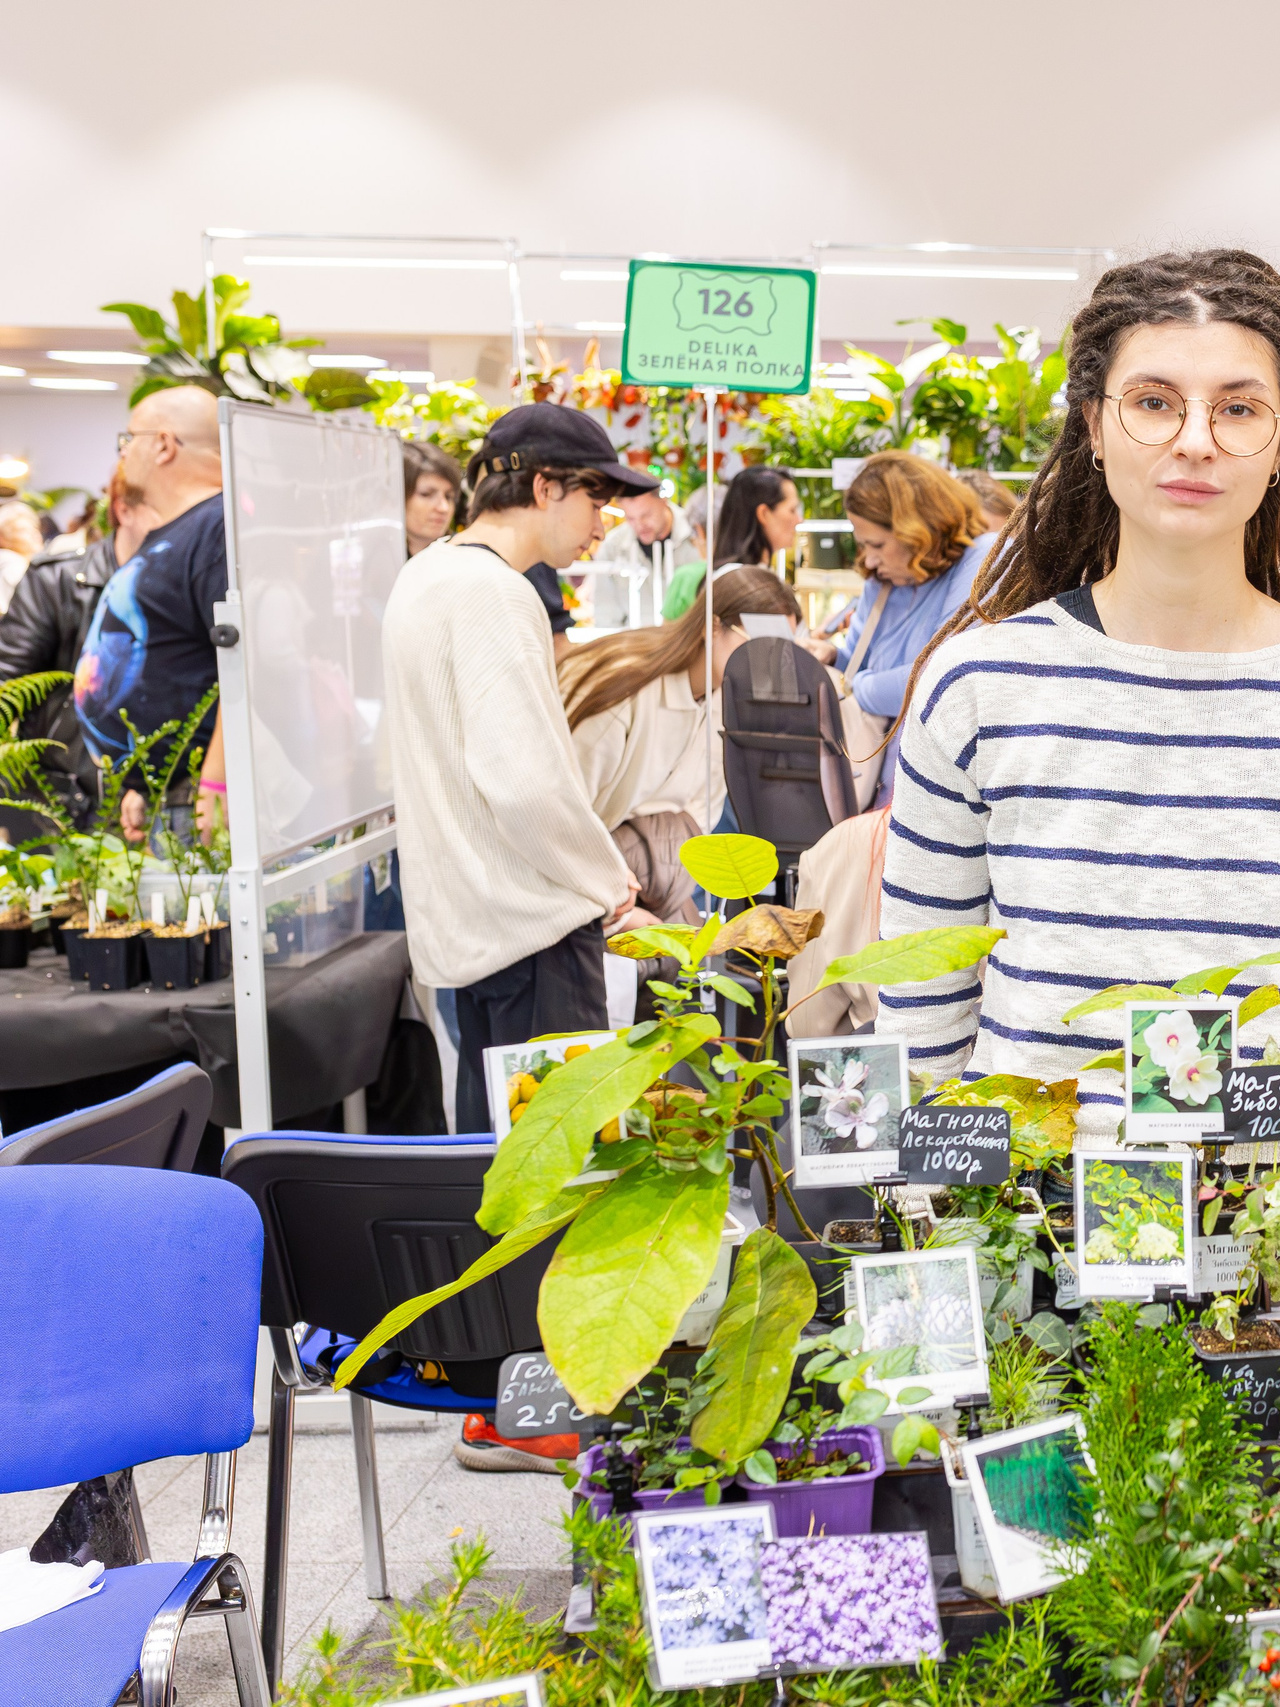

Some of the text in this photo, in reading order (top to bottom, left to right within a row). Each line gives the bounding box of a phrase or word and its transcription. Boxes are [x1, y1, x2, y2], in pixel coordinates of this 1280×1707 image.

[698, 288, 754, 317] 126
[688, 340, 758, 357] DELIKA
[638, 353, 805, 377] ЗЕЛЁНАЯ ПОЛКА
[900, 1108, 1009, 1132] Магнолия
[1206, 1243, 1252, 1255] Магноли
[1216, 1272, 1239, 1283] 1000
